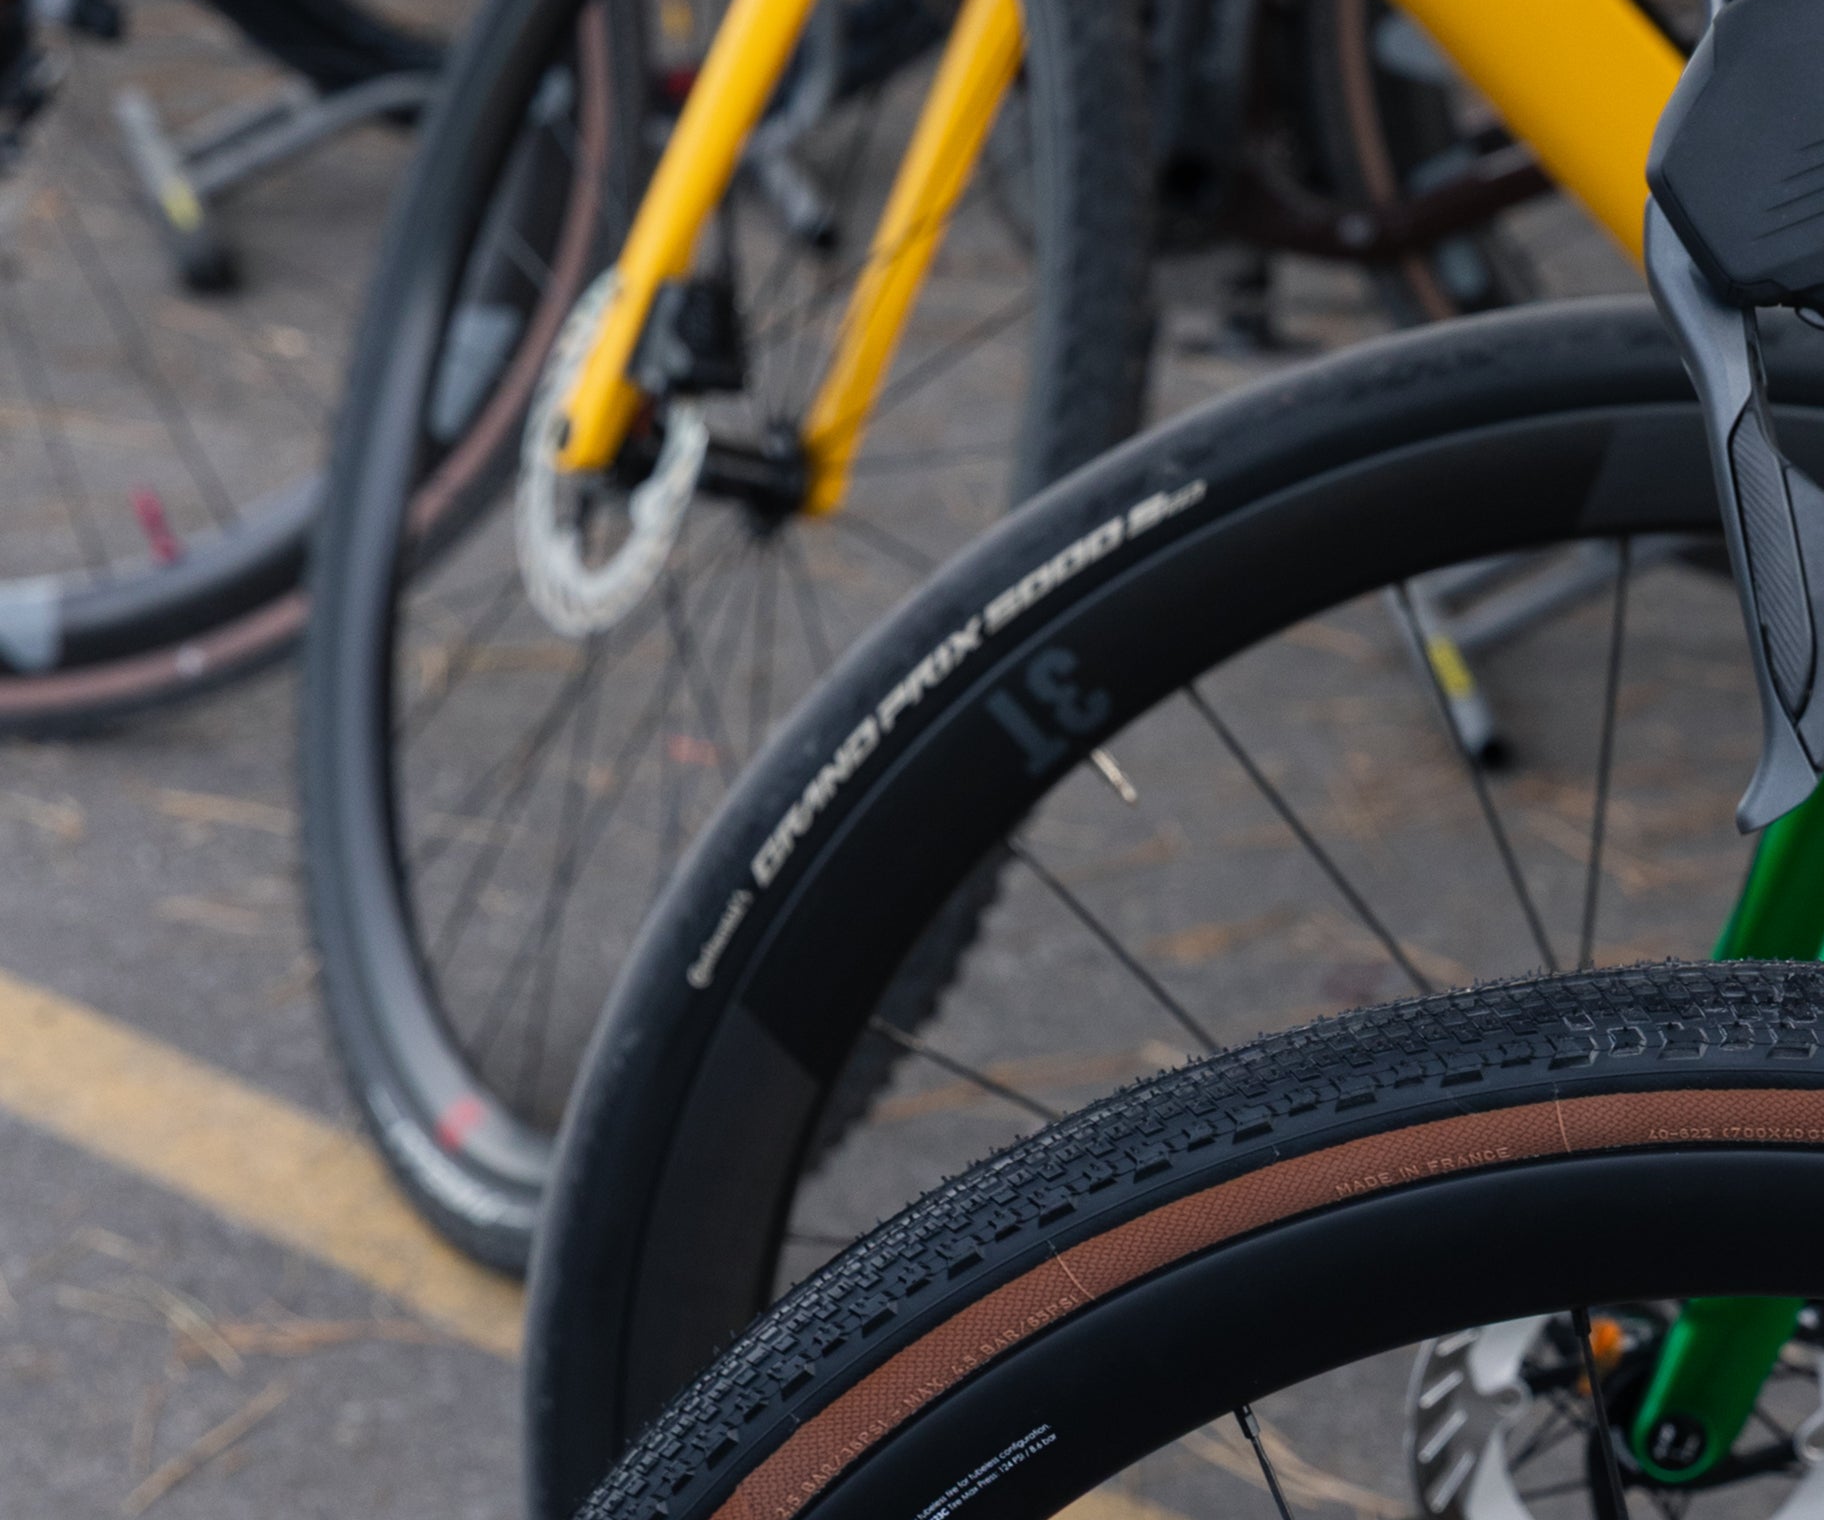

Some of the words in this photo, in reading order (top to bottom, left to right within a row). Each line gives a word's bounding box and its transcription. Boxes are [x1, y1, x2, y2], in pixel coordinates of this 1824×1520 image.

[748, 713, 881, 889] GRAND
[875, 614, 982, 735] PRIX
[983, 514, 1125, 636] 5000
[1335, 1171, 1392, 1196] MADE
[1399, 1164, 1419, 1179] IN
[1427, 1146, 1511, 1173] FRANCE
[980, 1294, 1079, 1355] BAR/65PSI
[1040, 1433, 1057, 1446] bar
